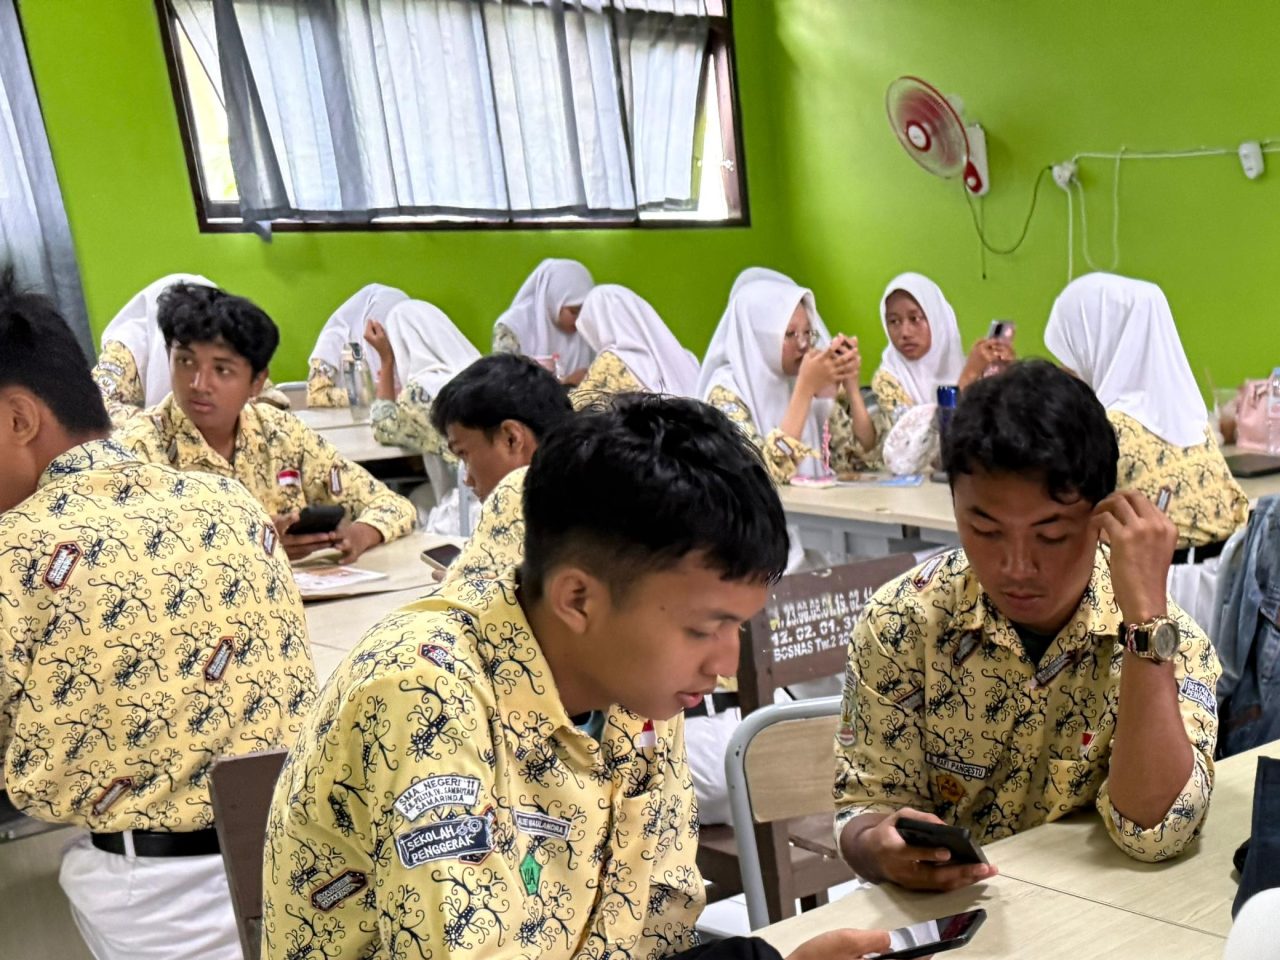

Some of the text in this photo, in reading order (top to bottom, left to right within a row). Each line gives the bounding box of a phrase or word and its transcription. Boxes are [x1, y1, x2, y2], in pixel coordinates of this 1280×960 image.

[796, 625, 817, 641] 02.
[820, 619, 840, 635] 01.
[774, 641, 813, 662] BOSNAS
[399, 788, 420, 807] SMA
[423, 777, 460, 791] NEGERI
[415, 794, 464, 812] SAMARINDA
[407, 824, 456, 851] SEKOLAH
[411, 834, 475, 863] PENGGERAK
